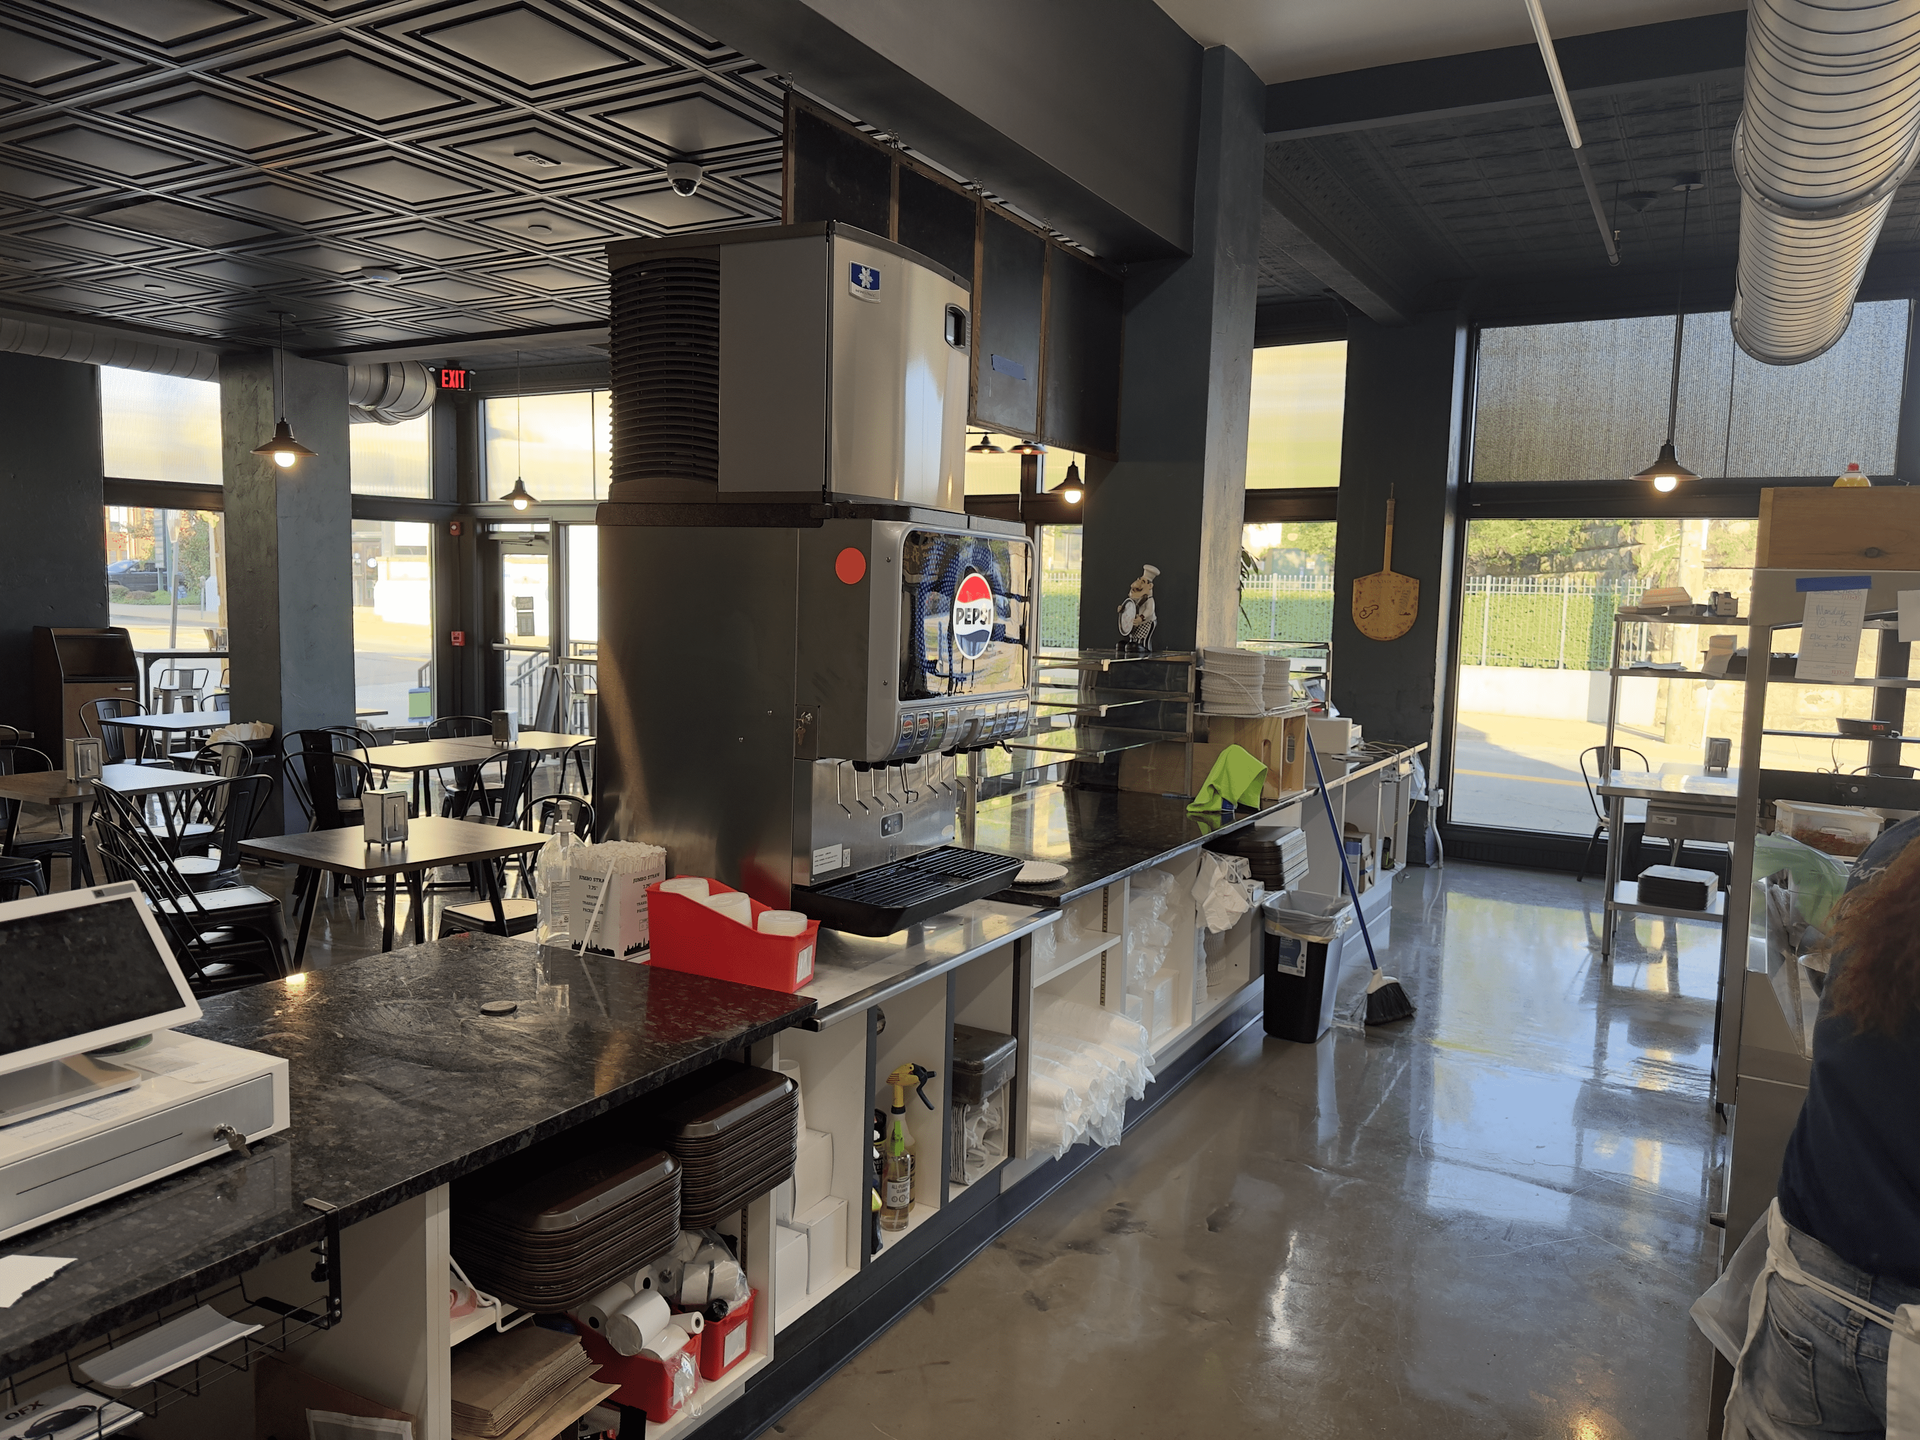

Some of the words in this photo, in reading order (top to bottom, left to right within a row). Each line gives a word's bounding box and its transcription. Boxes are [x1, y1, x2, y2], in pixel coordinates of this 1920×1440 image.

[441, 369, 466, 389] EXIT
[955, 607, 992, 625] PEPSI
[4, 1399, 45, 1421] OFX
